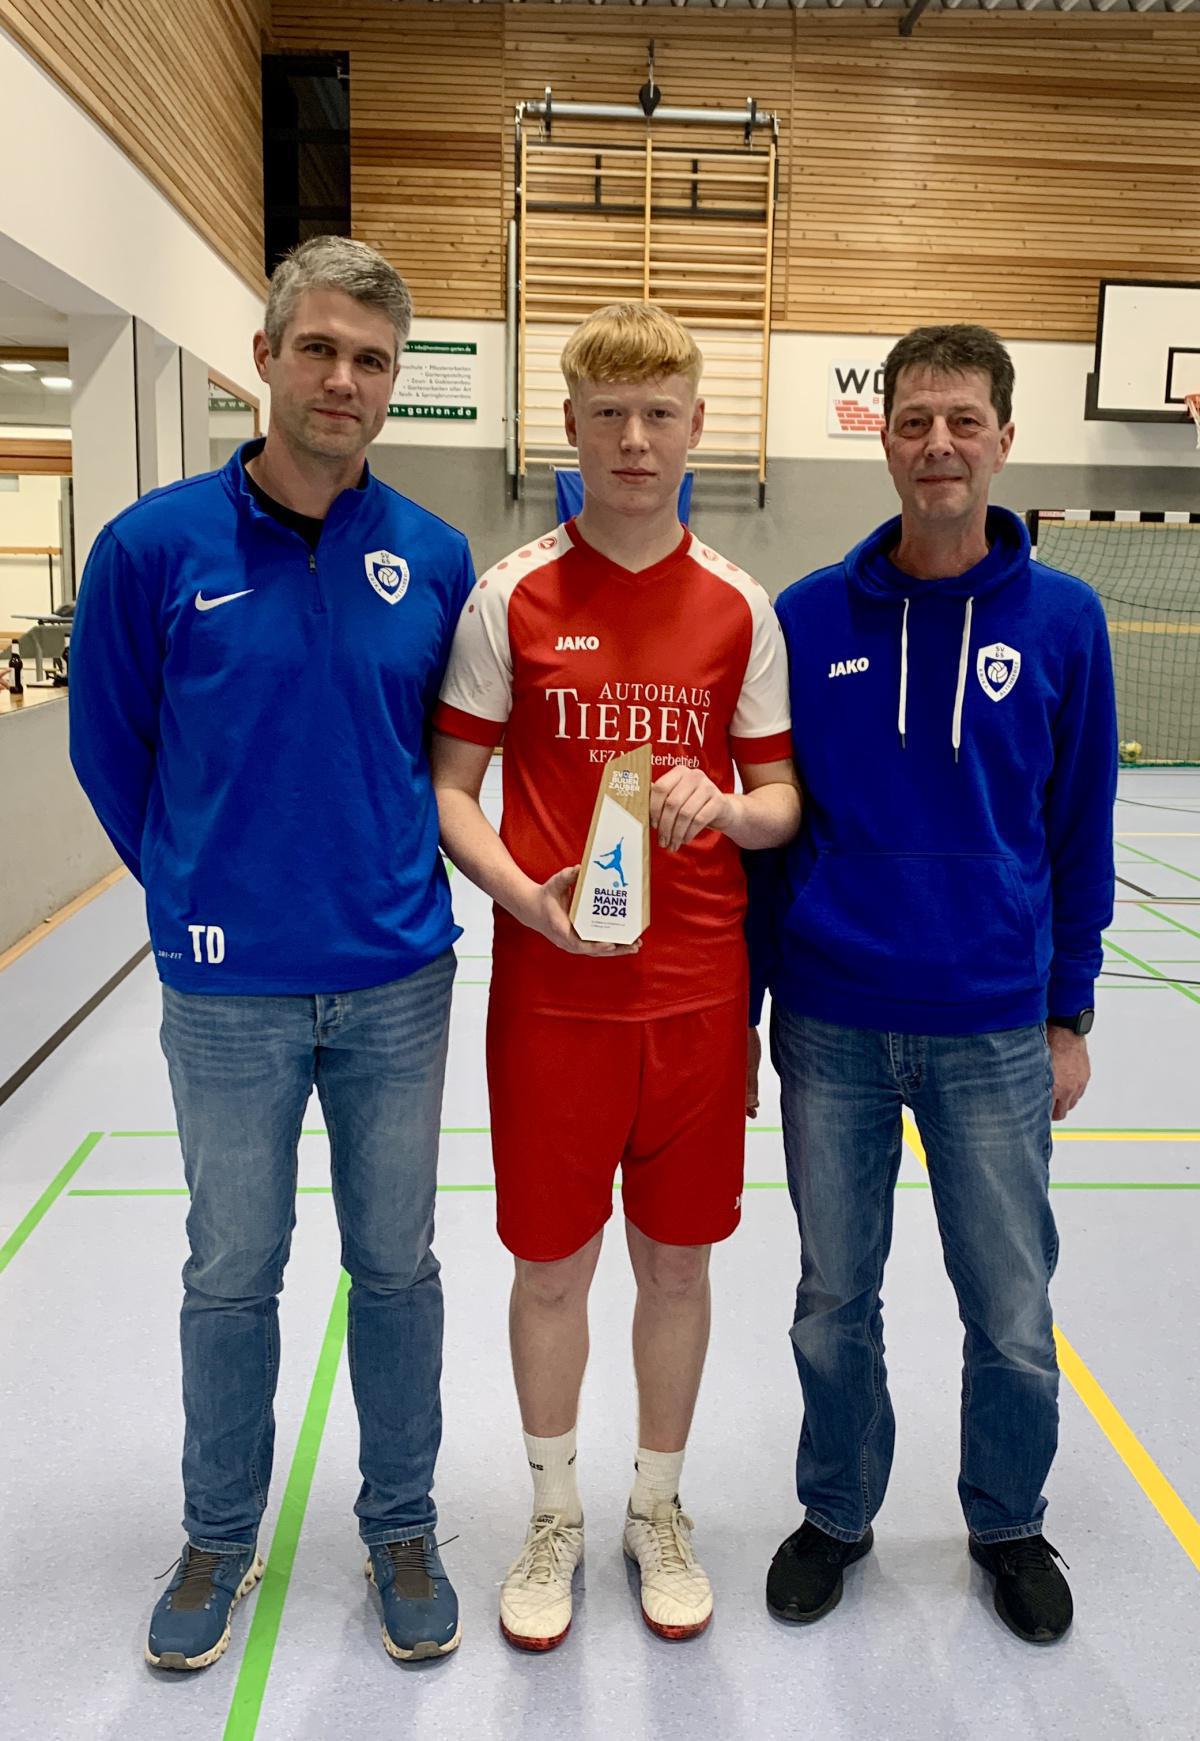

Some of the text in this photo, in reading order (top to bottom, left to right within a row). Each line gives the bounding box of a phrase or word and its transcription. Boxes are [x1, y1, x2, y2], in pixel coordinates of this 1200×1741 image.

[555, 636, 600, 651] JAKO
[828, 657, 870, 679] JAKO
[598, 682, 711, 708] AUTOHAUS
[589, 749, 616, 763] KFZ
[594, 887, 628, 897] BALLER
[593, 896, 627, 906] MANN
[592, 904, 627, 918] 2024
[188, 925, 225, 964] TD
